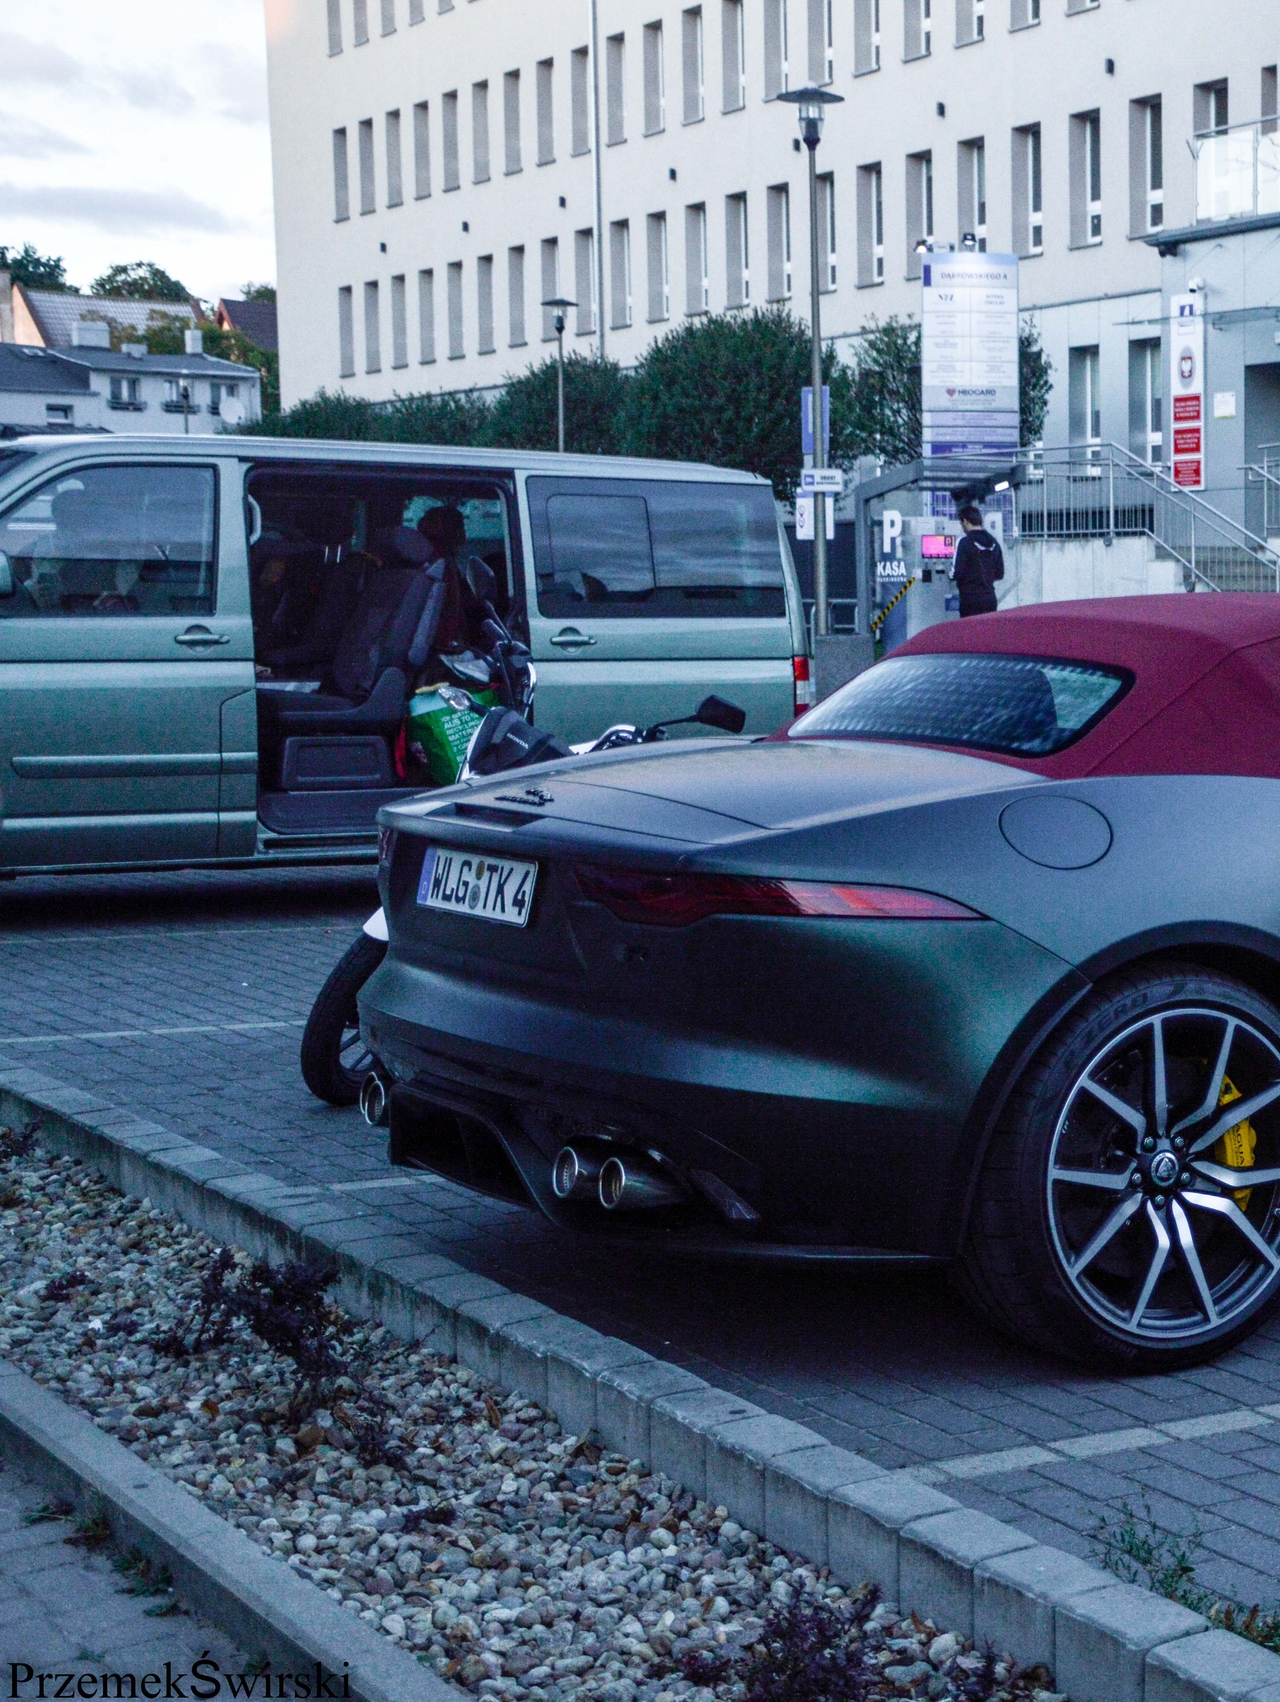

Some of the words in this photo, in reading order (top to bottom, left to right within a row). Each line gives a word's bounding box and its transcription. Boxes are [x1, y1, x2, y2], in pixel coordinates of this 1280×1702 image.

[883, 510, 902, 553] P
[877, 561, 907, 576] KASA
[444, 719, 460, 729] AUS
[506, 733, 529, 750] HONDA
[430, 855, 473, 905] WLG
[482, 863, 514, 914] TK
[512, 870, 531, 917] 4
[1235, 1124, 1245, 1165] AGUA
